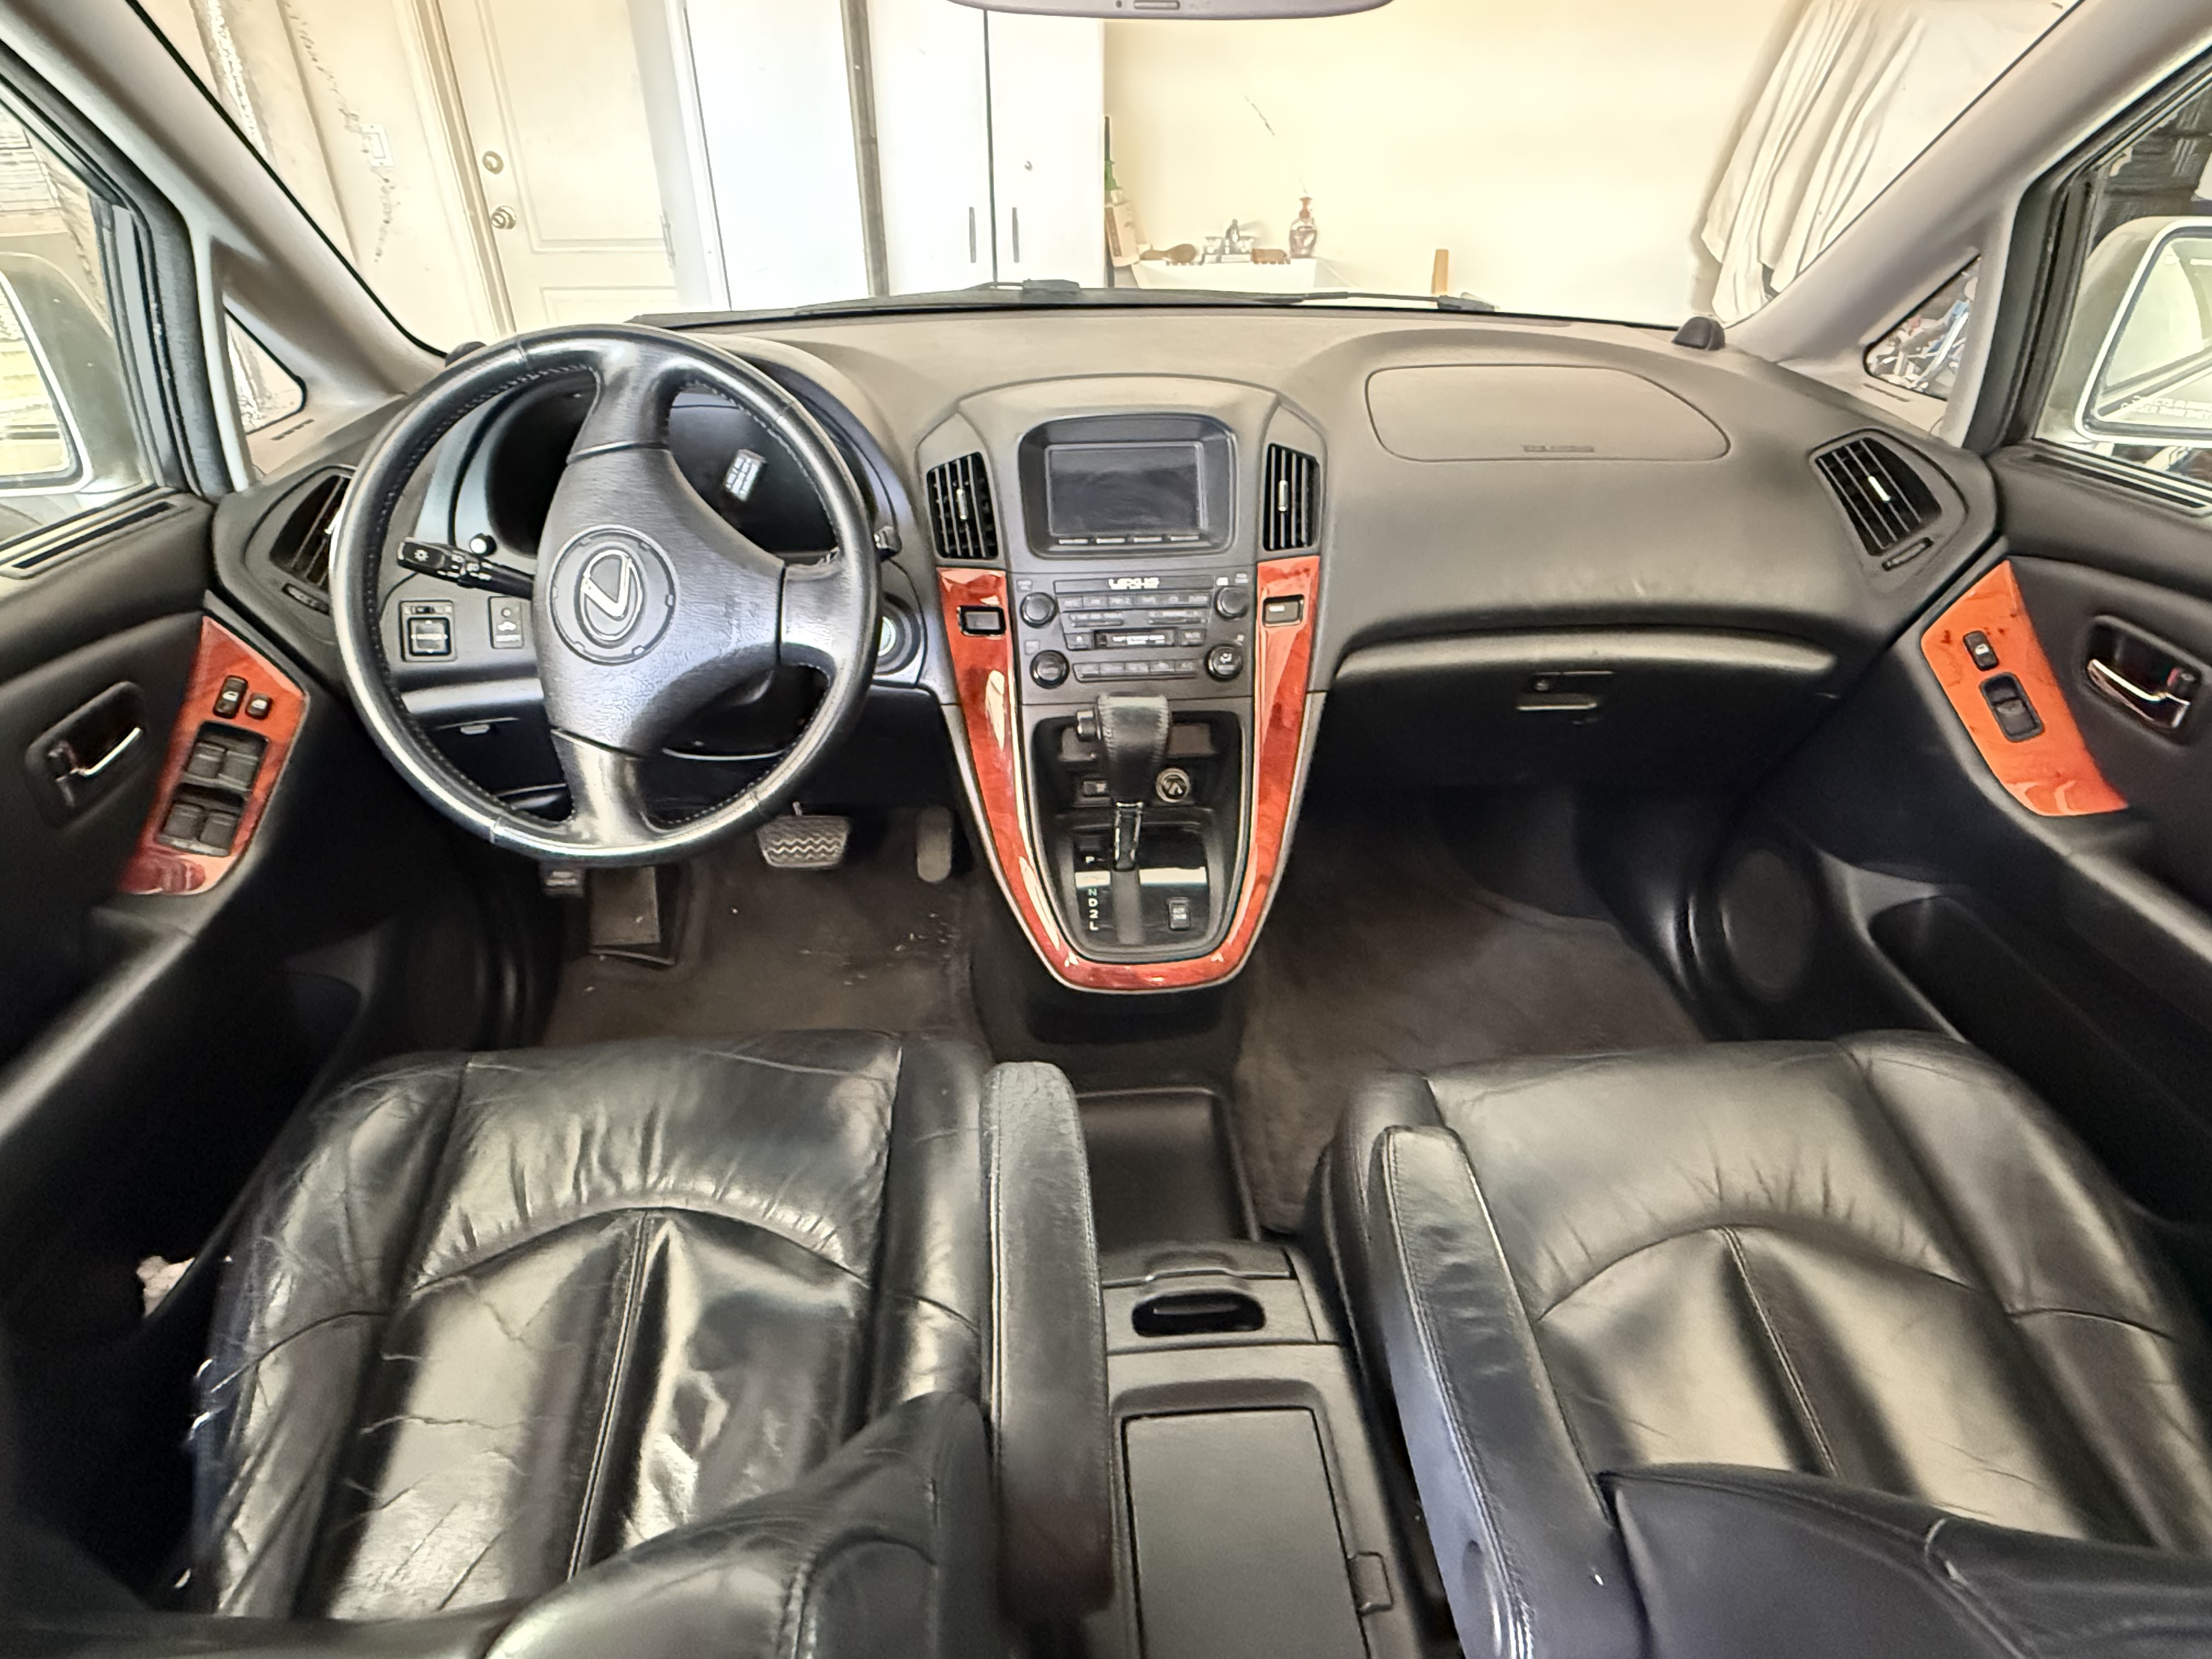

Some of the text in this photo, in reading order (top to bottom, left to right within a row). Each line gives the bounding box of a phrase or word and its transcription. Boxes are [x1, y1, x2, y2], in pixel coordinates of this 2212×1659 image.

[1088, 888, 1097, 896] N
[1088, 898, 1098, 907] D
[1089, 909, 1098, 918] 2
[1089, 921, 1099, 930] L
